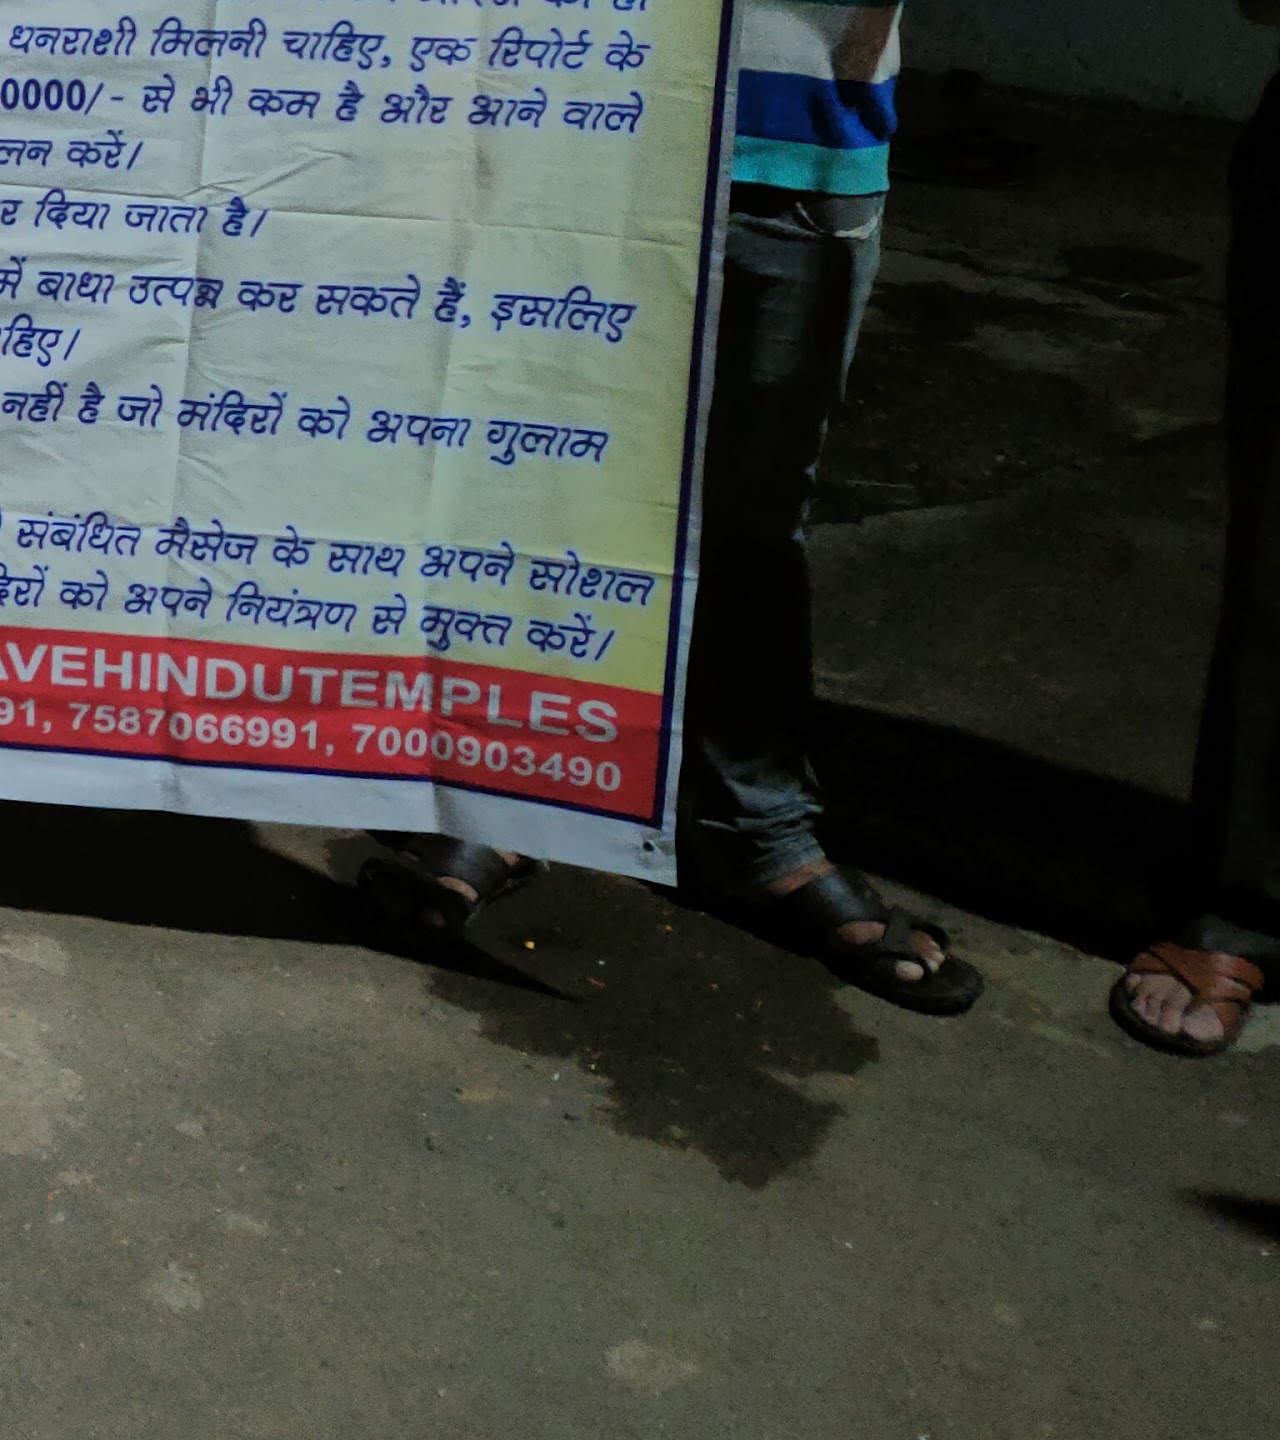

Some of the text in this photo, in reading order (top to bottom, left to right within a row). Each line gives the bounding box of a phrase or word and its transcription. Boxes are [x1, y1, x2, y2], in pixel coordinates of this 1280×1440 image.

[9, 16, 136, 55] धनराशी
[151, 16, 267, 57] मिलनी
[283, 20, 391, 69] चाहिए,
[488, 27, 593, 69] रिपोर्ट
[381, 84, 454, 123] और
[468, 88, 547, 128] आने
[563, 91, 644, 132] वाले
[34, 187, 111, 230] दिया
[125, 195, 208, 233] जाता
[37, 271, 115, 304] बाधा
[316, 275, 421, 319] सकते
[491, 286, 637, 343] इसलिए
[2, 380, 68, 422] नहीं
[177, 389, 287, 435] मंदिरों
[367, 410, 472, 447] अपना
[487, 420, 609, 465] गुलाम
[17, 510, 141, 556] संबंधित
[156, 517, 258, 565] मैसेज
[328, 542, 406, 577] साथ
[420, 541, 516, 586] अपने
[529, 551, 655, 605] सोशल
[124, 577, 213, 619] अपने
[226, 581, 357, 632] नियंत्रण
[420, 605, 512, 652] मुक्त
[69, 702, 334, 756] 7587066991,
[352, 724, 621, 792] 7000903490
